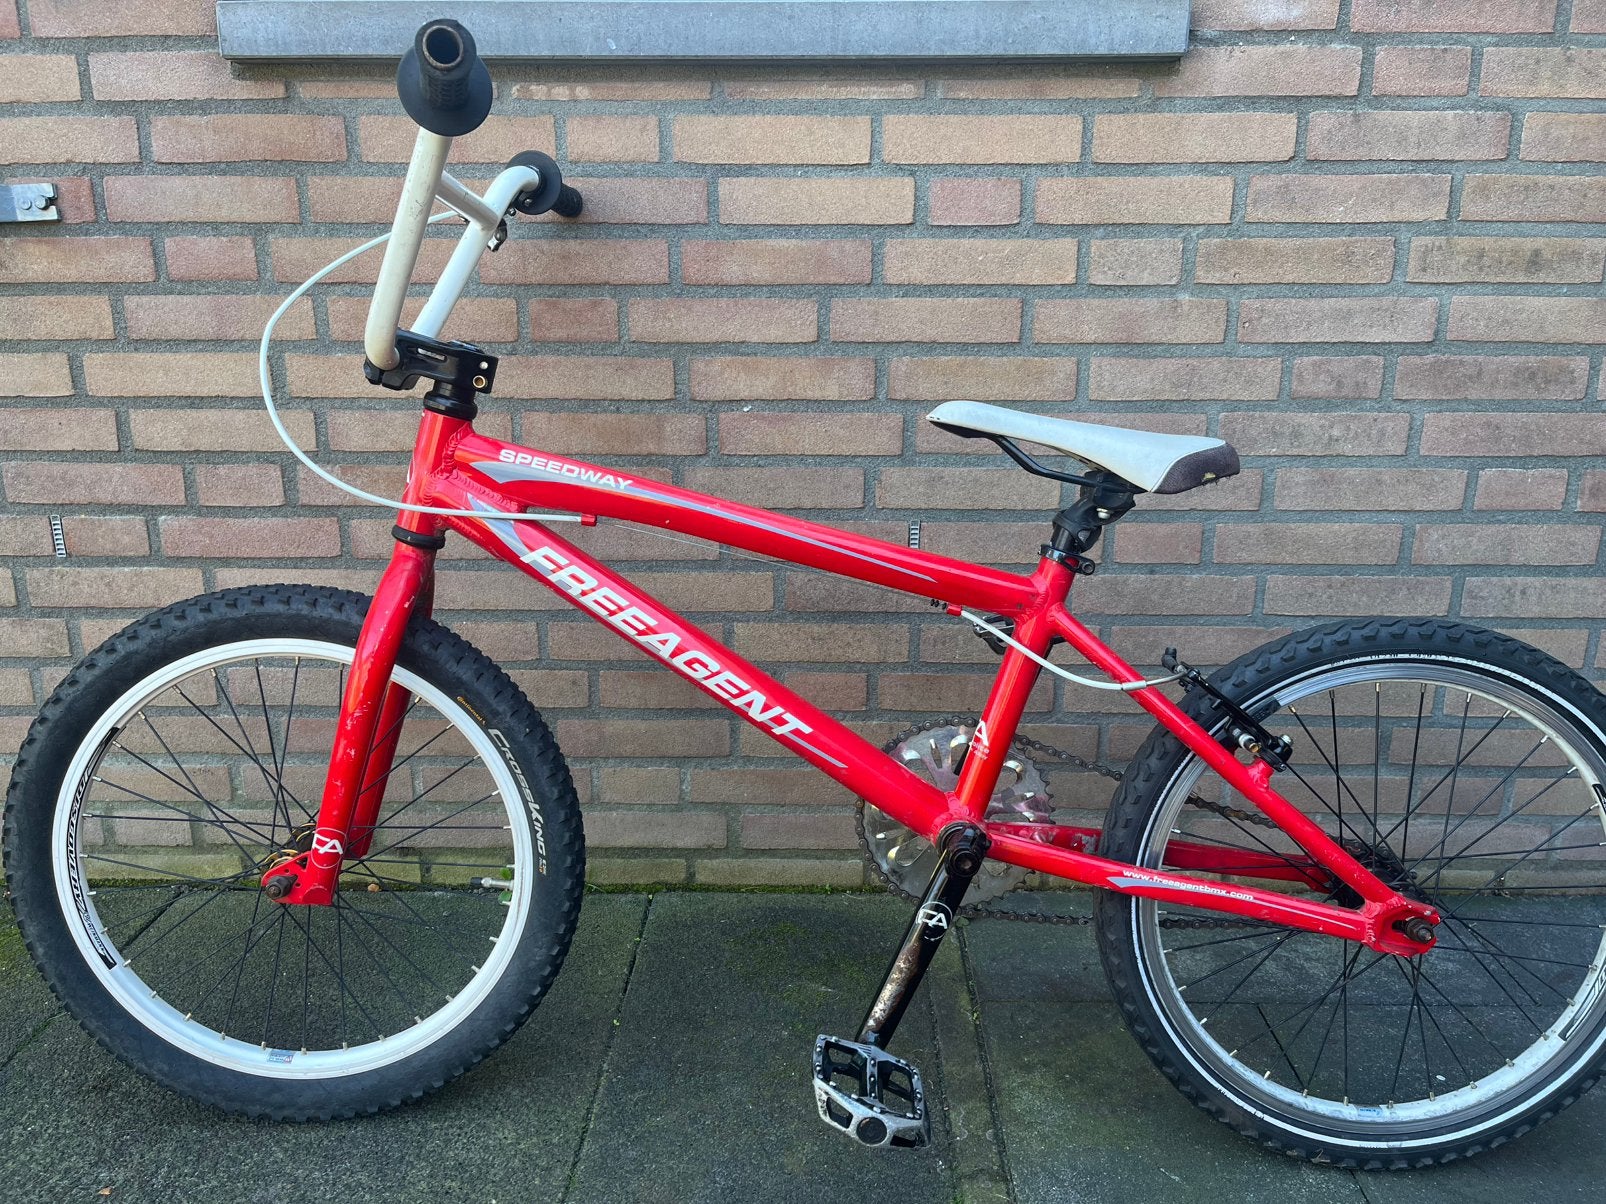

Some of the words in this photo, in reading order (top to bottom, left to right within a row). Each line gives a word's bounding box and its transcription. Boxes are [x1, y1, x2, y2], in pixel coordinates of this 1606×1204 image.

[498, 448, 634, 490] SPEEDWAY
[519, 545, 813, 735] FREEAGENT
[1122, 869, 1254, 901] www.freeagentbmx.com
